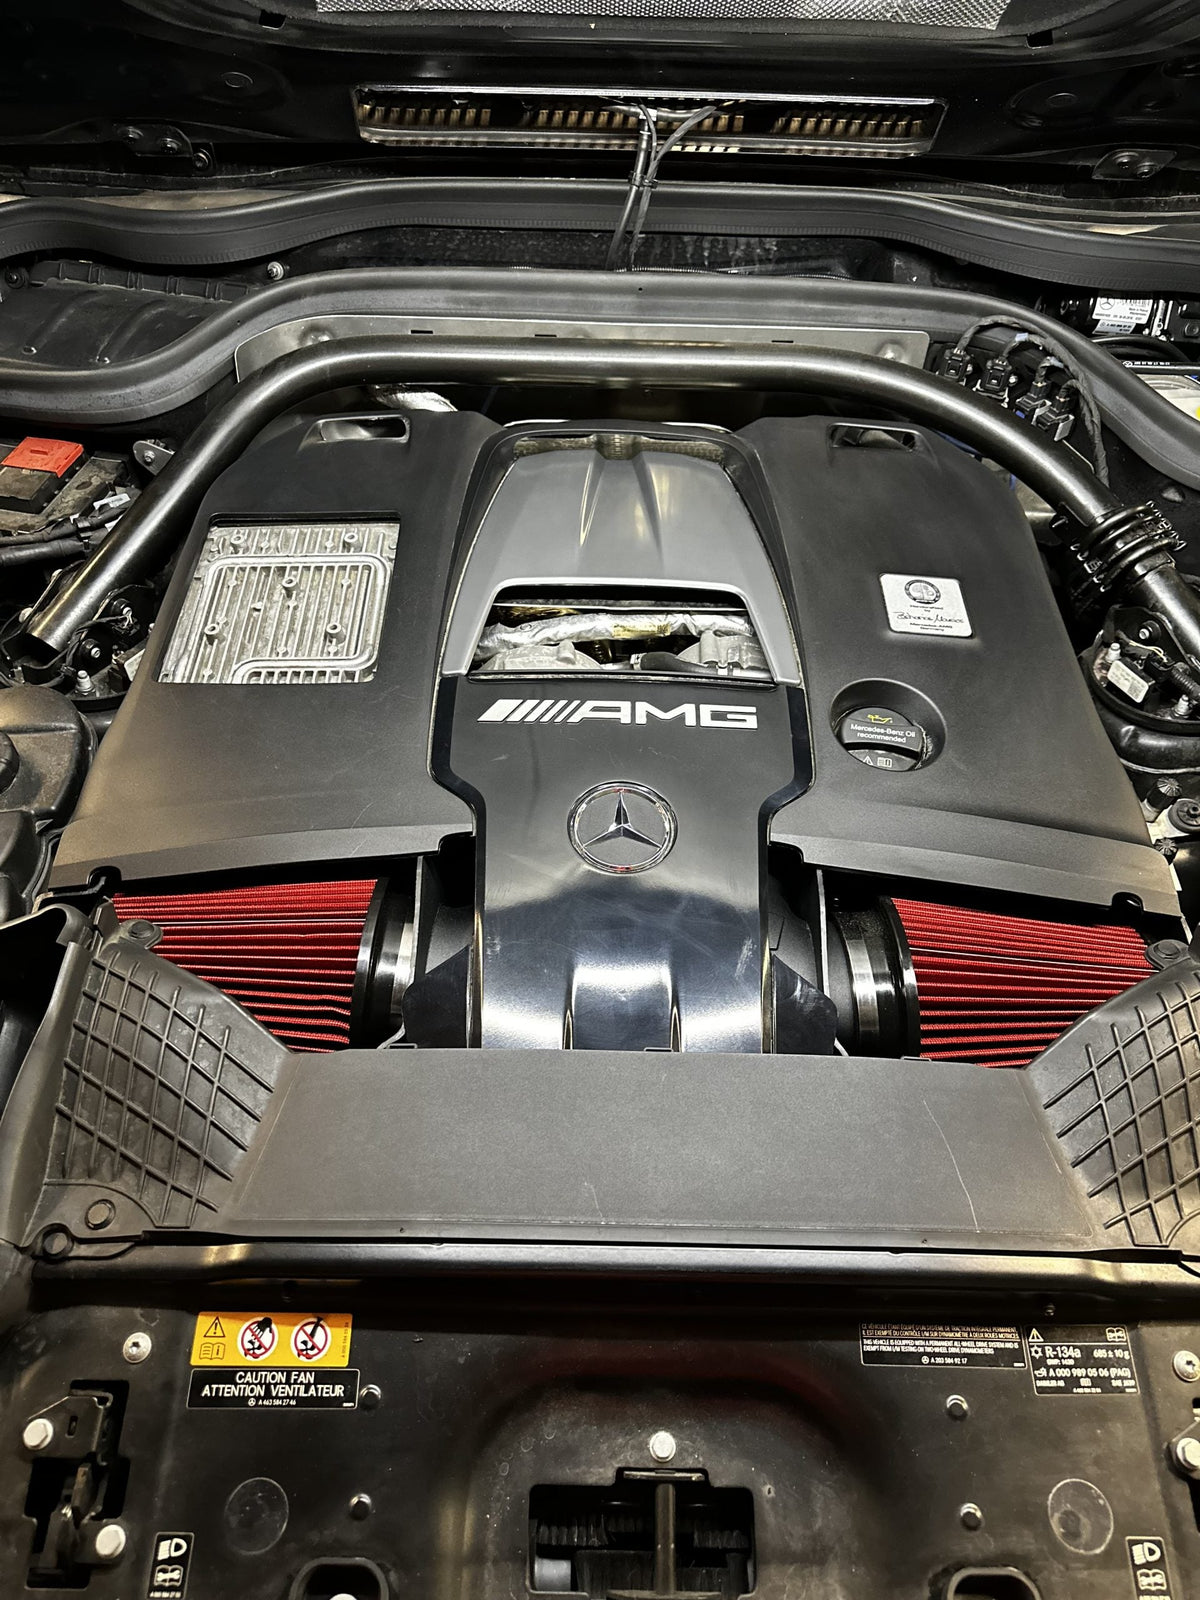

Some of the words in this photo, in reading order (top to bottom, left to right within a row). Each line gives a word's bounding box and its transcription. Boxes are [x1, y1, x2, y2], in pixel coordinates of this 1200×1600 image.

[850, 724, 904, 736] Mercedes-Benz
[905, 730, 916, 738] Oil
[857, 732, 907, 743] recommended
[1044, 1346, 1081, 1358] R-134a
[1093, 1349, 1107, 1358] 685
[1114, 1349, 1123, 1358] 10
[236, 1372, 286, 1384] CAUTION
[290, 1372, 315, 1384] FAN
[1049, 1368, 1056, 1377] A
[1056, 1368, 1071, 1377] 000
[1071, 1368, 1086, 1377] 989
[1087, 1368, 1098, 1377] 05
[1098, 1368, 1109, 1377] 06
[1110, 1368, 1131, 1378] (PAG)
[200, 1384, 266, 1397] ATTENTION
[270, 1384, 345, 1397] VENTILATEUR
